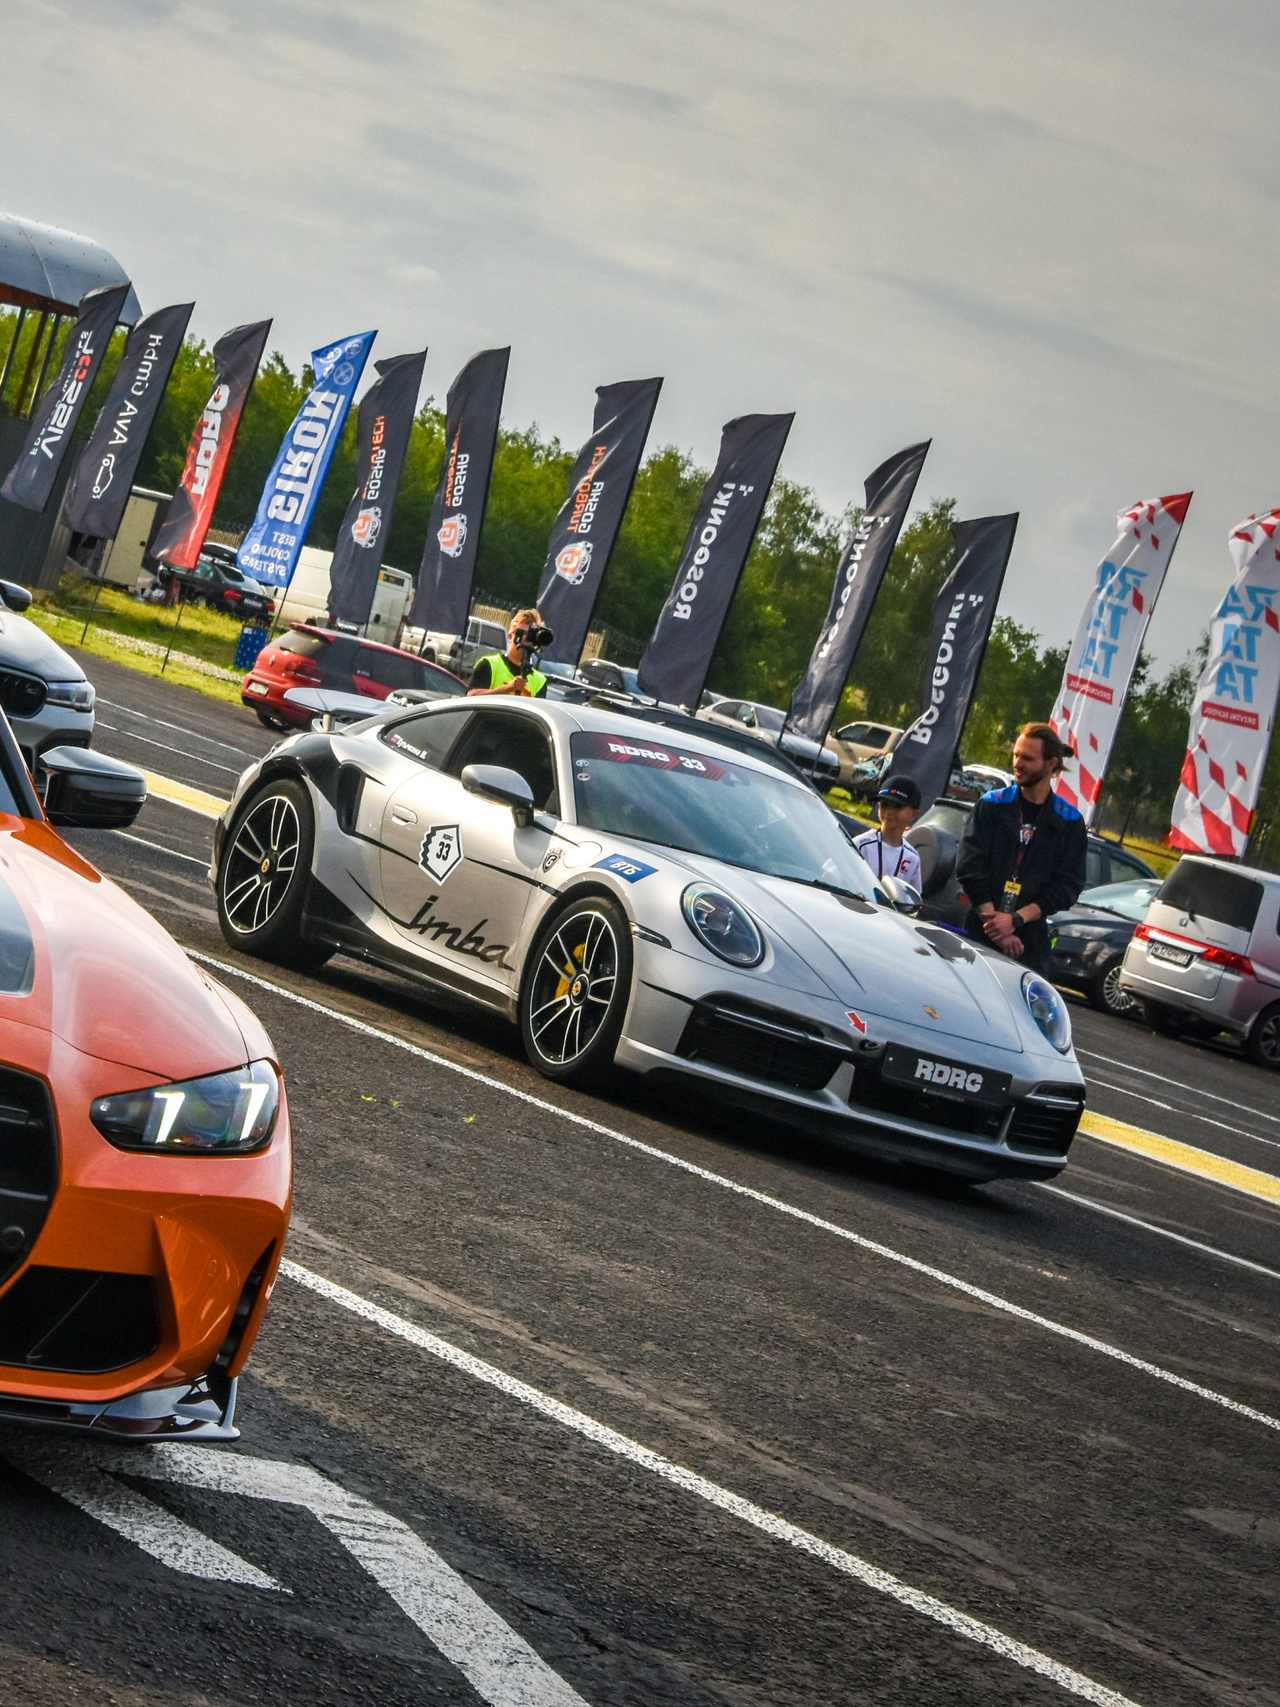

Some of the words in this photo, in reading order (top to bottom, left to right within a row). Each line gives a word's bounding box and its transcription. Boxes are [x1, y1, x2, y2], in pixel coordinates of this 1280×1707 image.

[608, 743, 670, 762] RDRC
[679, 756, 706, 772] 33
[435, 841, 451, 862] 33
[609, 860, 642, 876] ВТБ
[915, 1058, 984, 1093] RDRC
